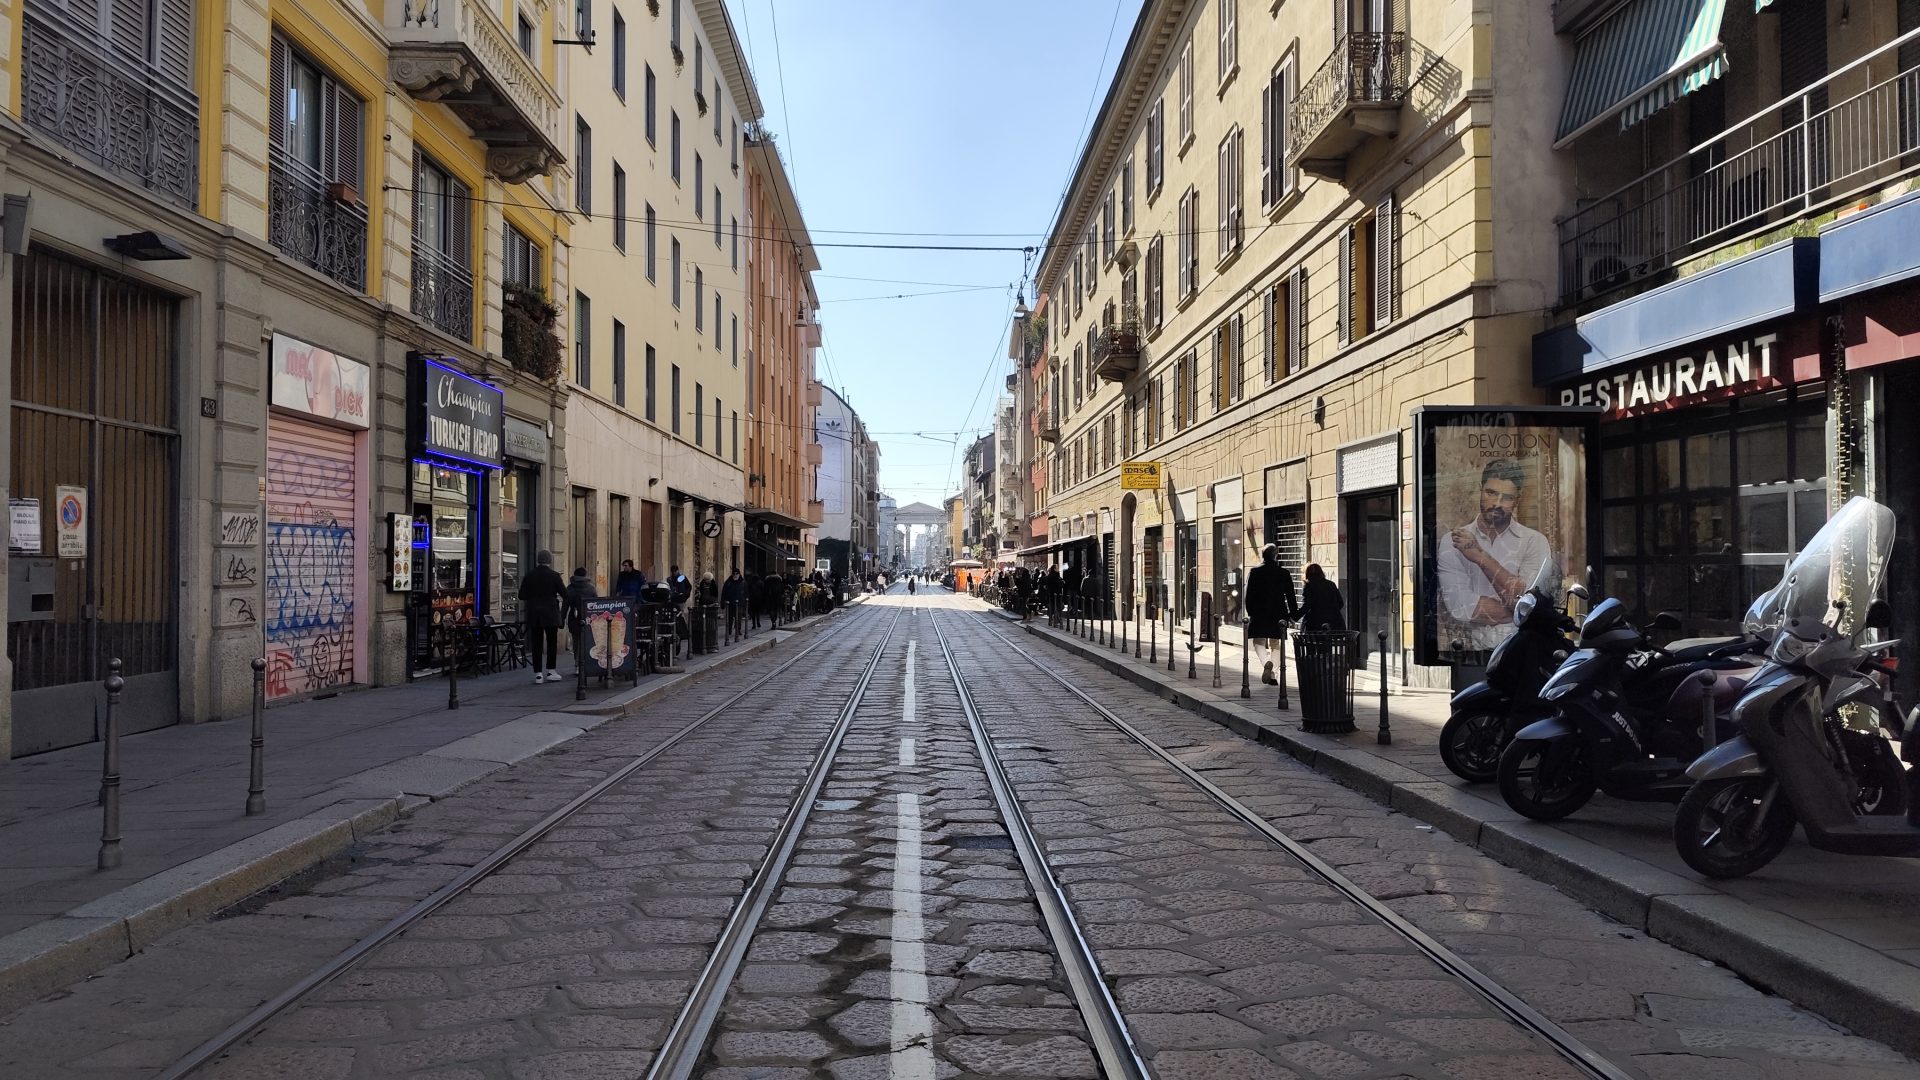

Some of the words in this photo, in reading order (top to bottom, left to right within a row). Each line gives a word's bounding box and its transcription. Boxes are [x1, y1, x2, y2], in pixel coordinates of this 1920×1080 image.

[1561, 333, 1777, 414] RESTAURANT
[335, 386, 363, 417] DICK
[437, 374, 491, 420] Champion
[430, 415, 470, 453] TURKISH
[1468, 434, 1551, 449] DEVOTION
[586, 601, 627, 611] Champion
